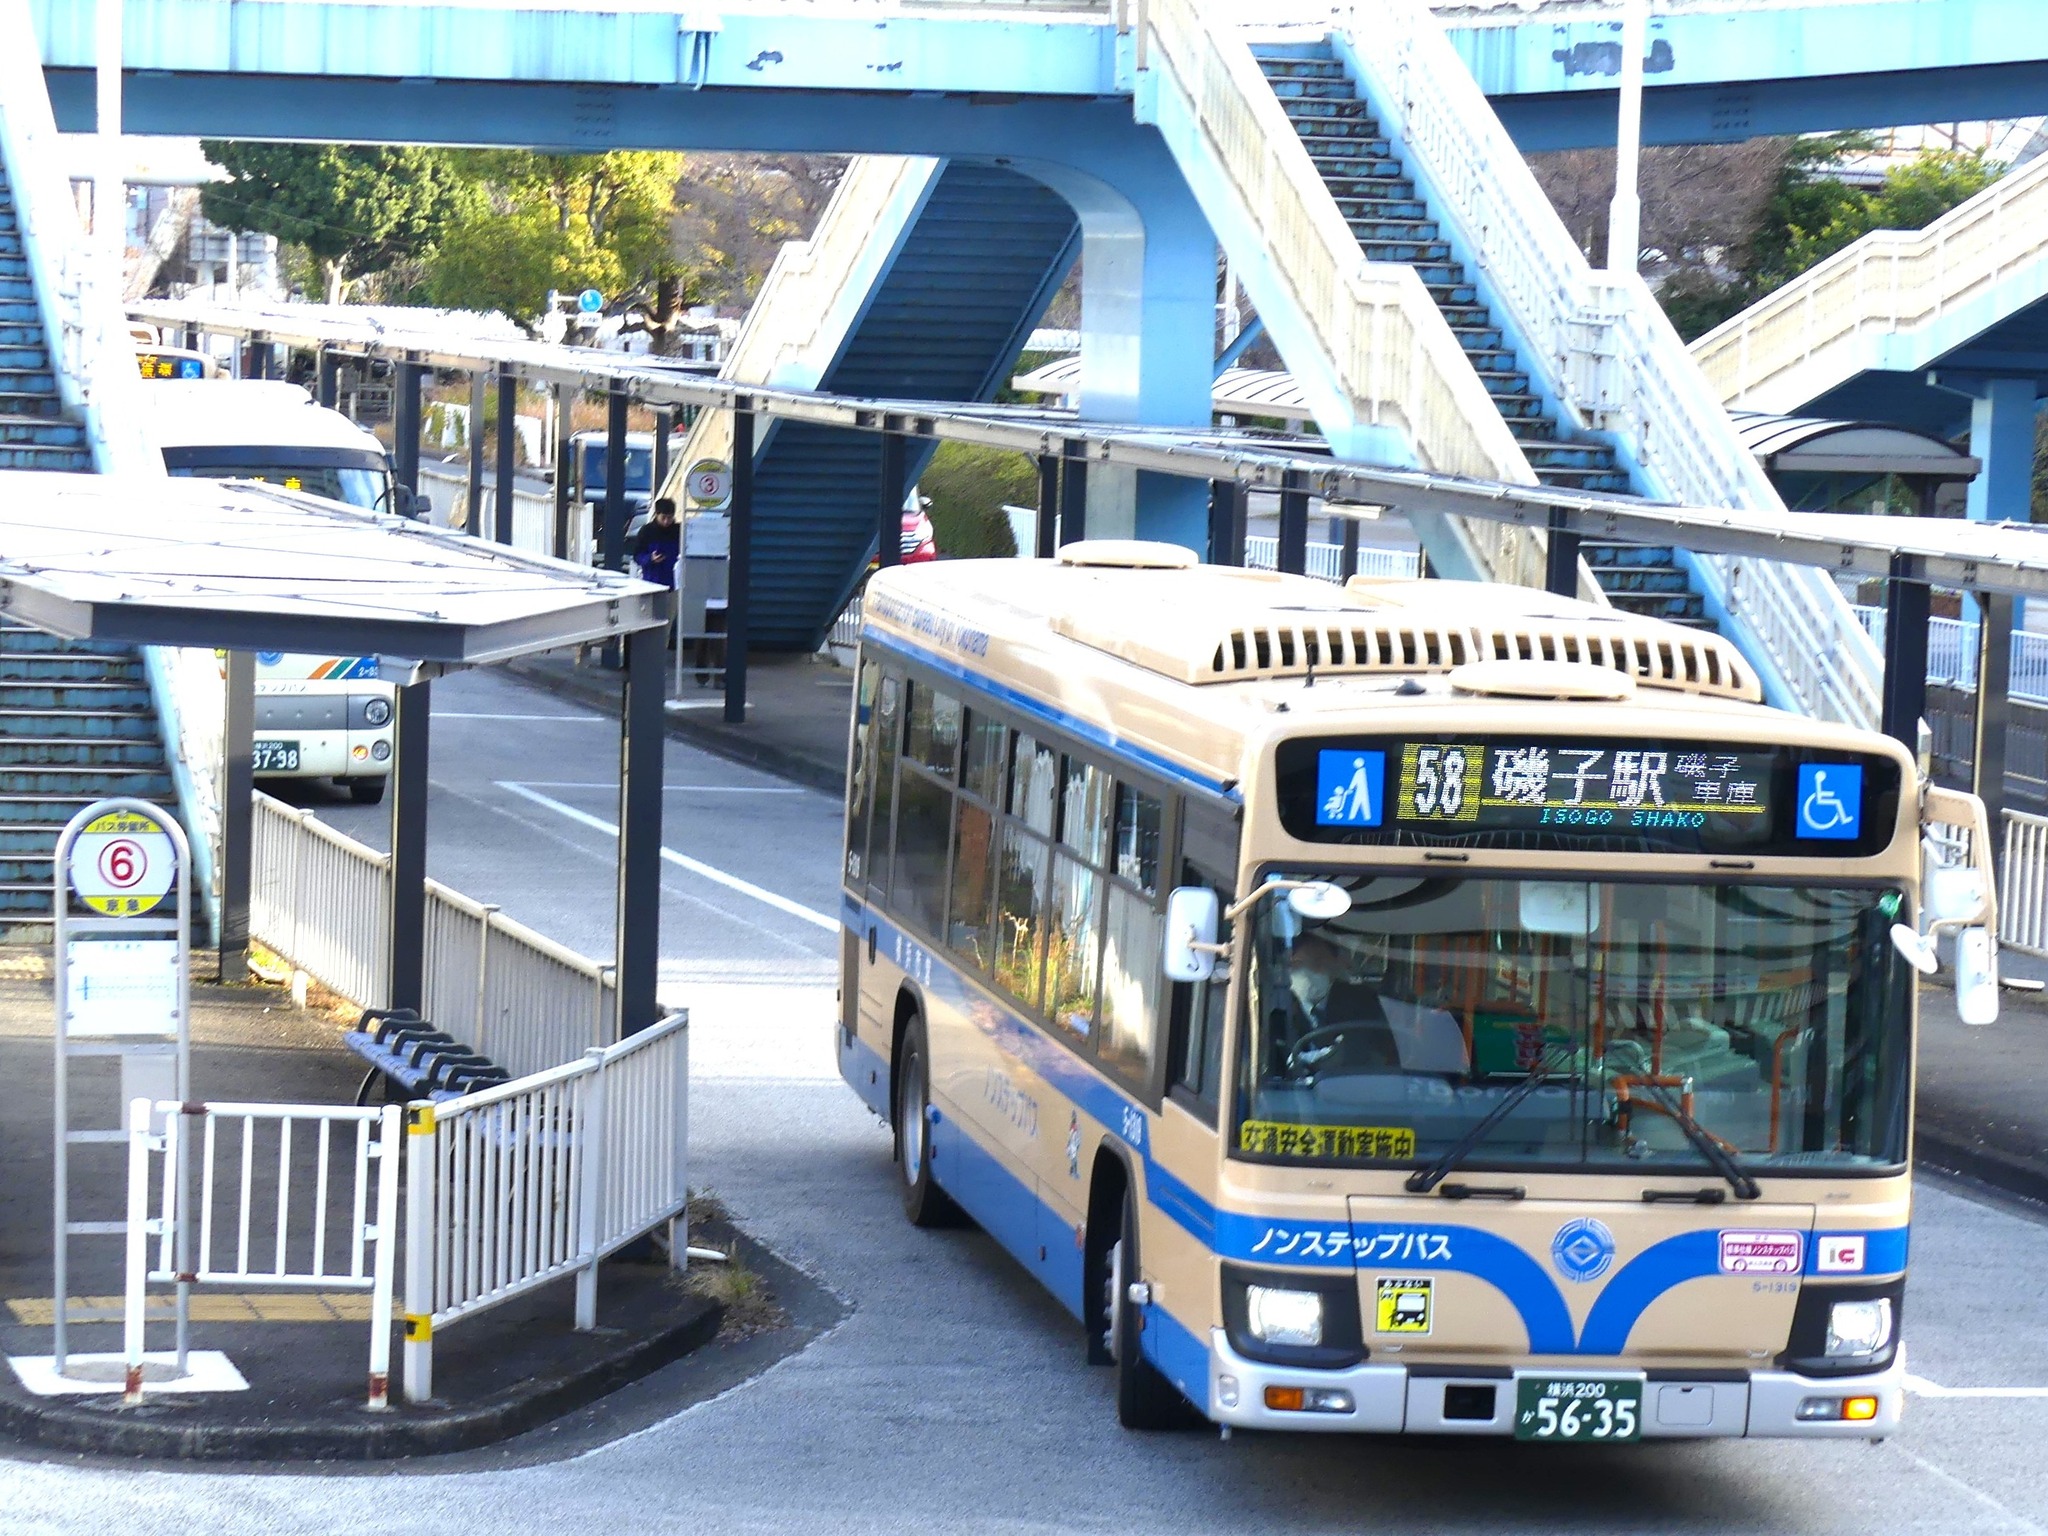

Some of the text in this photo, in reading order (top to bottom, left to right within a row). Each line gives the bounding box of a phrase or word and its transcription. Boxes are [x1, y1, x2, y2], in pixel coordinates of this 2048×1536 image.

[358, 666, 378, 676] 2-8
[252, 750, 298, 769] 37-98
[1674, 752, 1742, 779] 磯子
[1412, 748, 1466, 815] 58
[1492, 747, 1668, 808] 磯子駅
[1692, 779, 1758, 805] 車庫
[1539, 807, 1706, 828] ISOGO SHAKO
[1243, 1124, 1413, 1158] 交通安全運動実施中
[1251, 1227, 1453, 1261] ノンステップバス
[1536, 1398, 1637, 1438] 56-35
